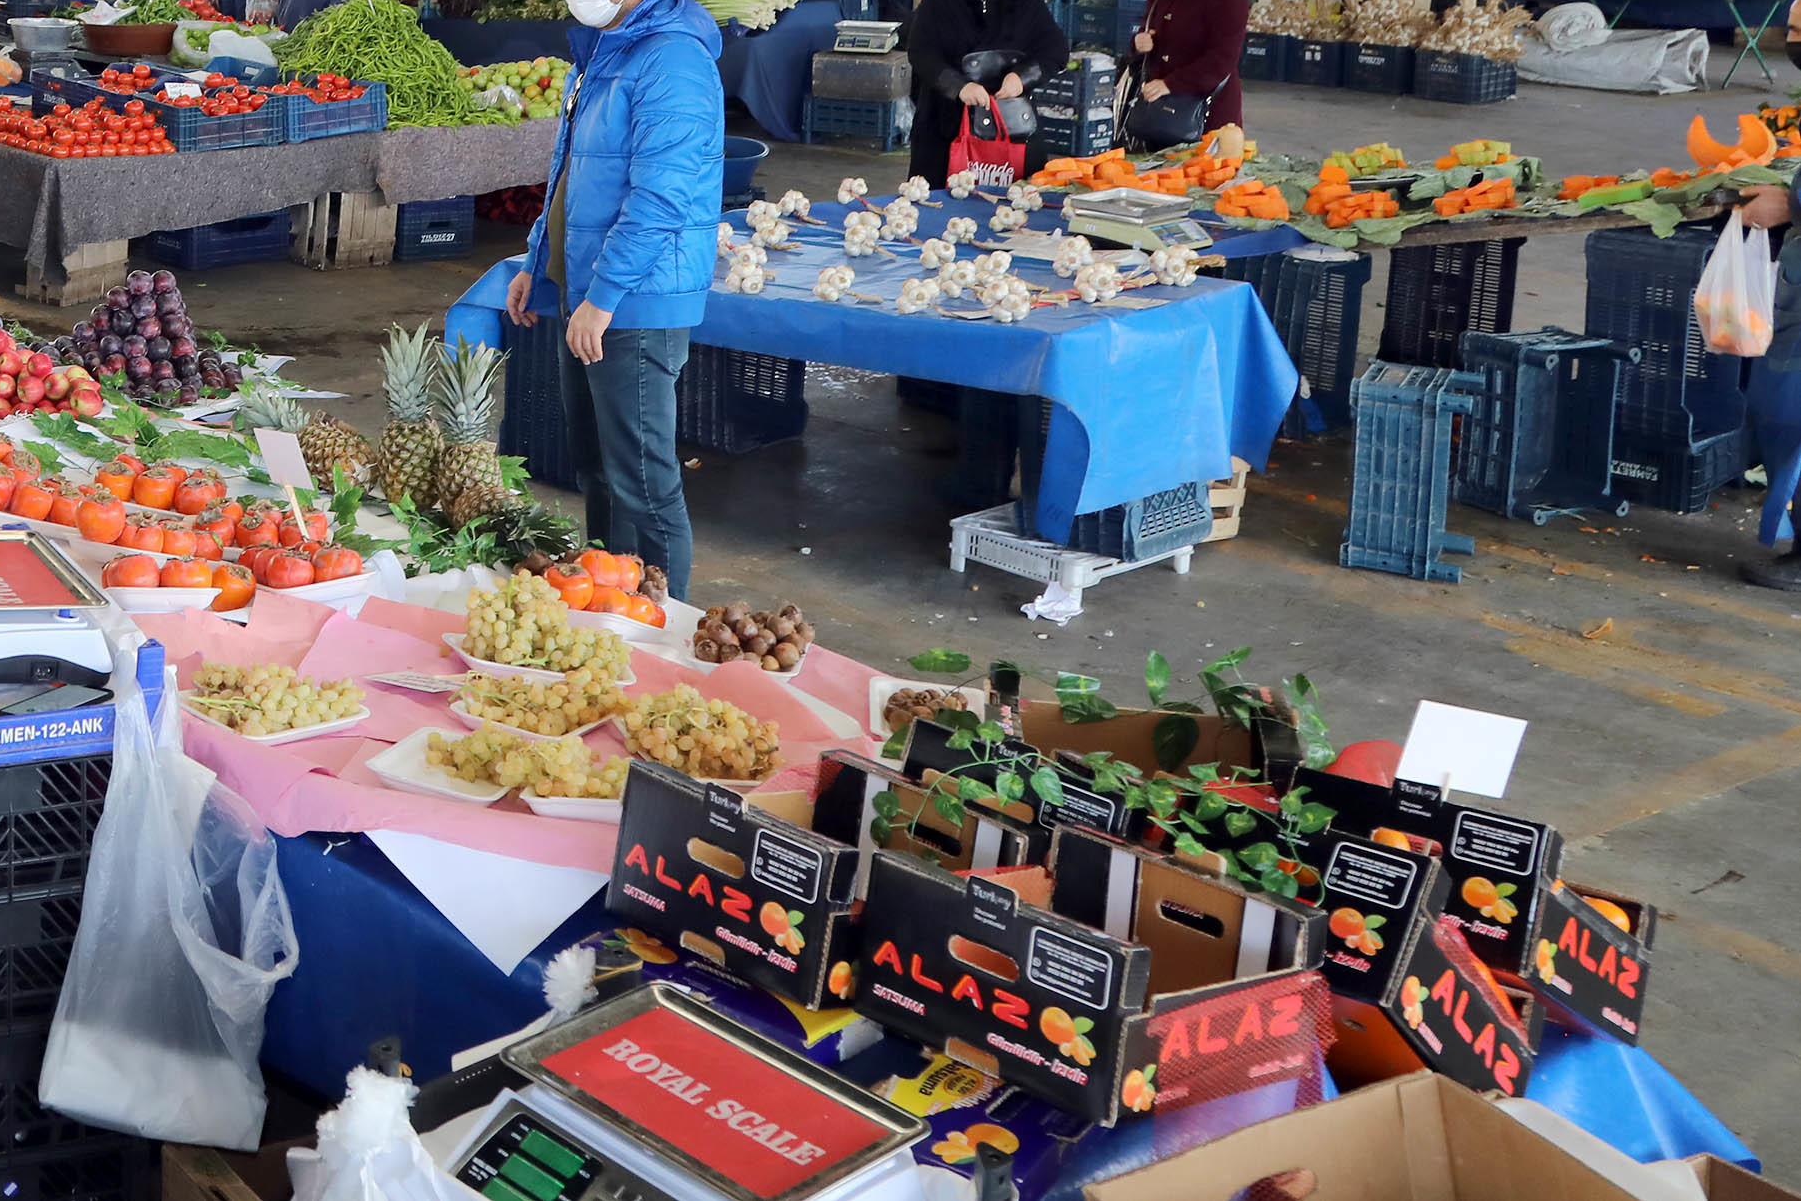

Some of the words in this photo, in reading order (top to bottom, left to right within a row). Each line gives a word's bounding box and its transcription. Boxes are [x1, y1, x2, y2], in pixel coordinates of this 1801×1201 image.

[623, 883, 666, 912] SATSUMA
[624, 844, 753, 923] ALAZ
[873, 940, 1031, 1030] ALAZ
[1558, 916, 1641, 999] ALAZ
[872, 982, 927, 1016] SATSUMA
[1159, 994, 1304, 1064] ALAZ
[1431, 969, 1521, 1096] ALAZ
[601, 1038, 712, 1106] ROYAL
[705, 1098, 827, 1167] SCALE
[919, 1060, 965, 1096] atsuma
